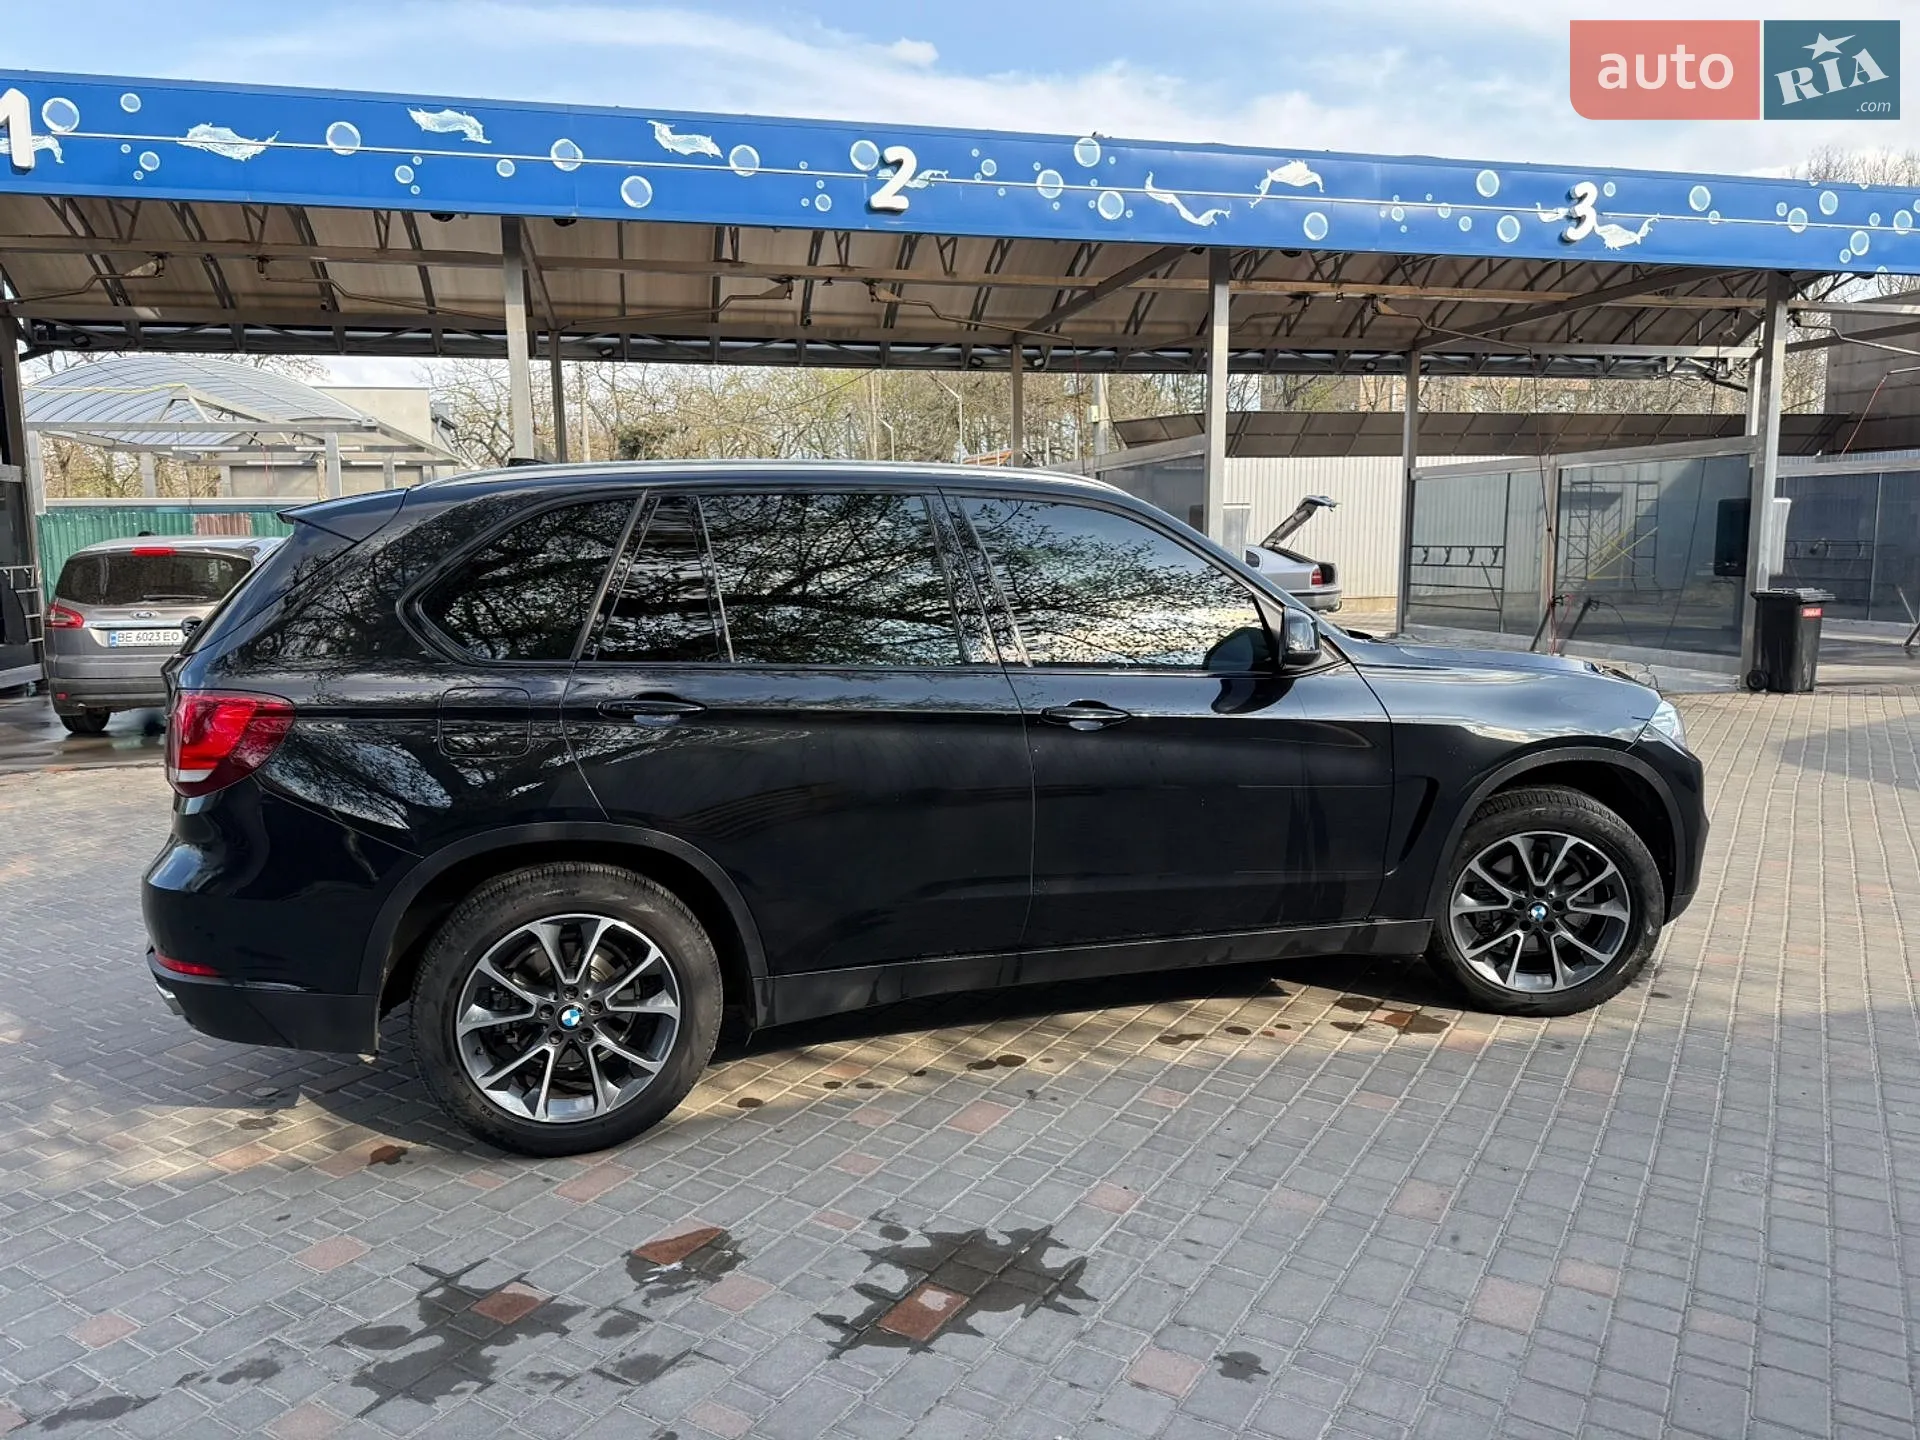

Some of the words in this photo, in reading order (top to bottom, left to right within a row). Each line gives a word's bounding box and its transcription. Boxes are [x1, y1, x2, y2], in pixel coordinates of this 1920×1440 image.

[0, 87, 35, 168] 1
[870, 145, 917, 210] 2
[1565, 181, 1598, 241] 3
[117, 632, 133, 643] BE
[136, 631, 161, 642] 6023
